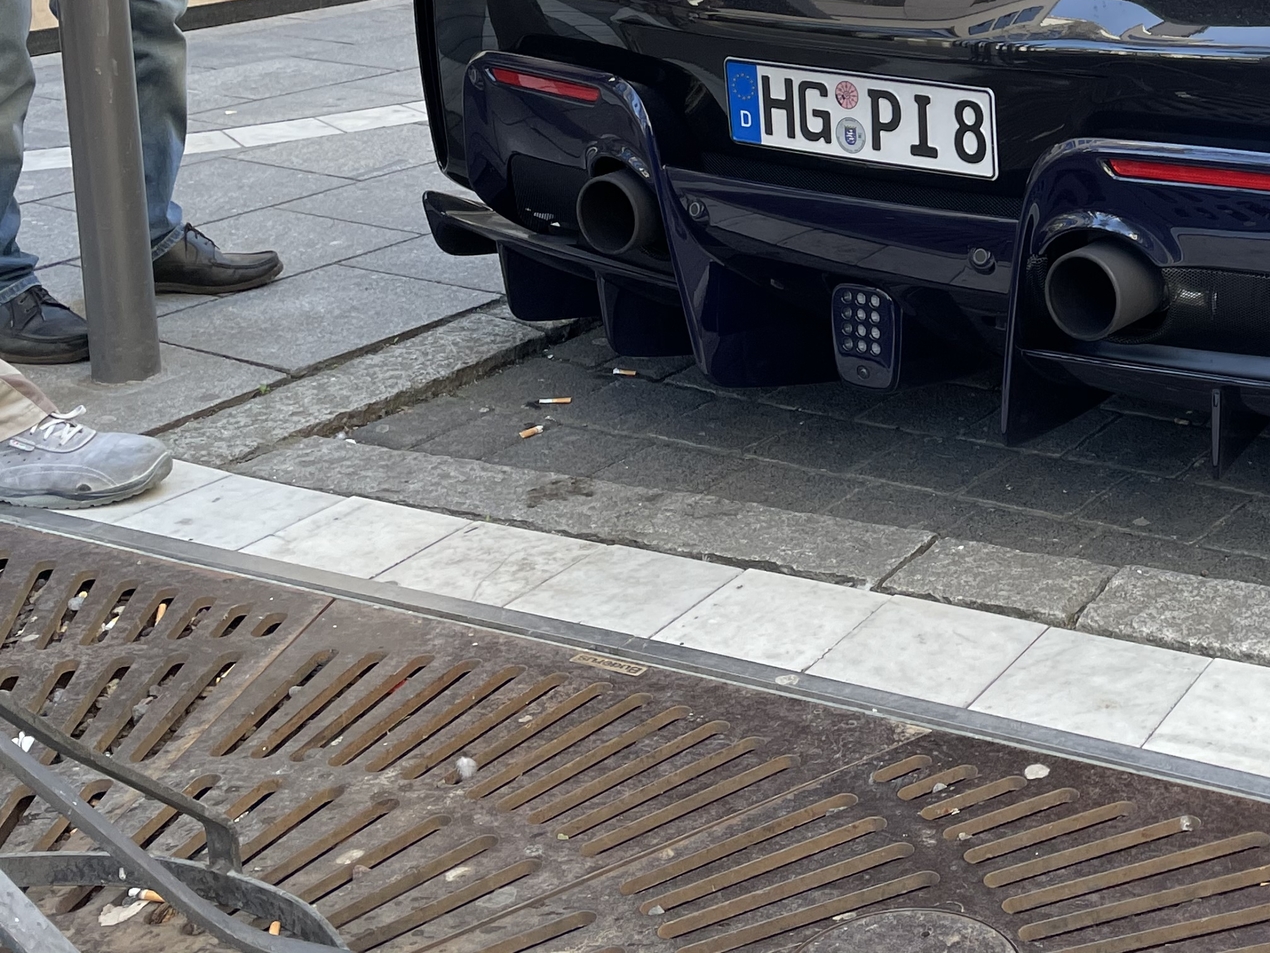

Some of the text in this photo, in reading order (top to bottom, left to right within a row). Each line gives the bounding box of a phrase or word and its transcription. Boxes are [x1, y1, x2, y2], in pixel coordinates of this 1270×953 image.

[740, 110, 752, 127] D
[761, 74, 832, 144] HG
[867, 88, 938, 160] PI
[954, 99, 987, 164] 8
